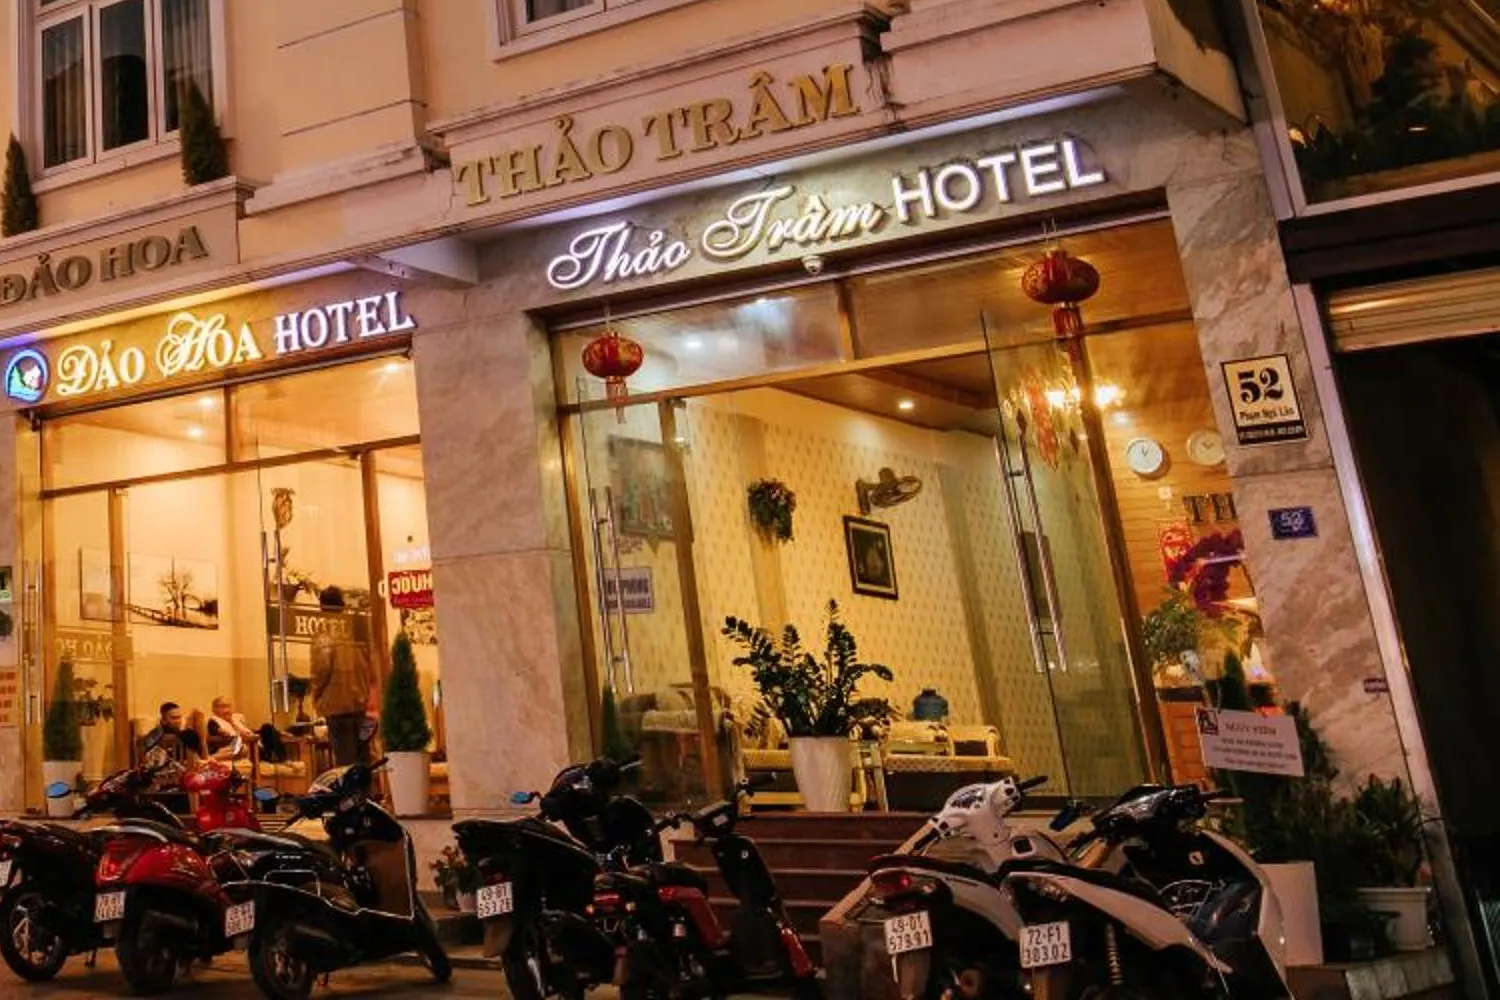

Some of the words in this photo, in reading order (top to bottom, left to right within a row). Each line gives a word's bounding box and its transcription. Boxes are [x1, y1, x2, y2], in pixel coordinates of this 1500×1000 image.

[454, 113, 634, 208] THẢO
[643, 63, 862, 163] TRÂM
[547, 221, 691, 290] Thảo
[702, 185, 885, 252] Trâm
[893, 139, 1105, 223] HOTEL
[100, 226, 209, 283] HOA
[274, 291, 415, 355] HOTEL
[1238, 366, 1284, 404] 52
